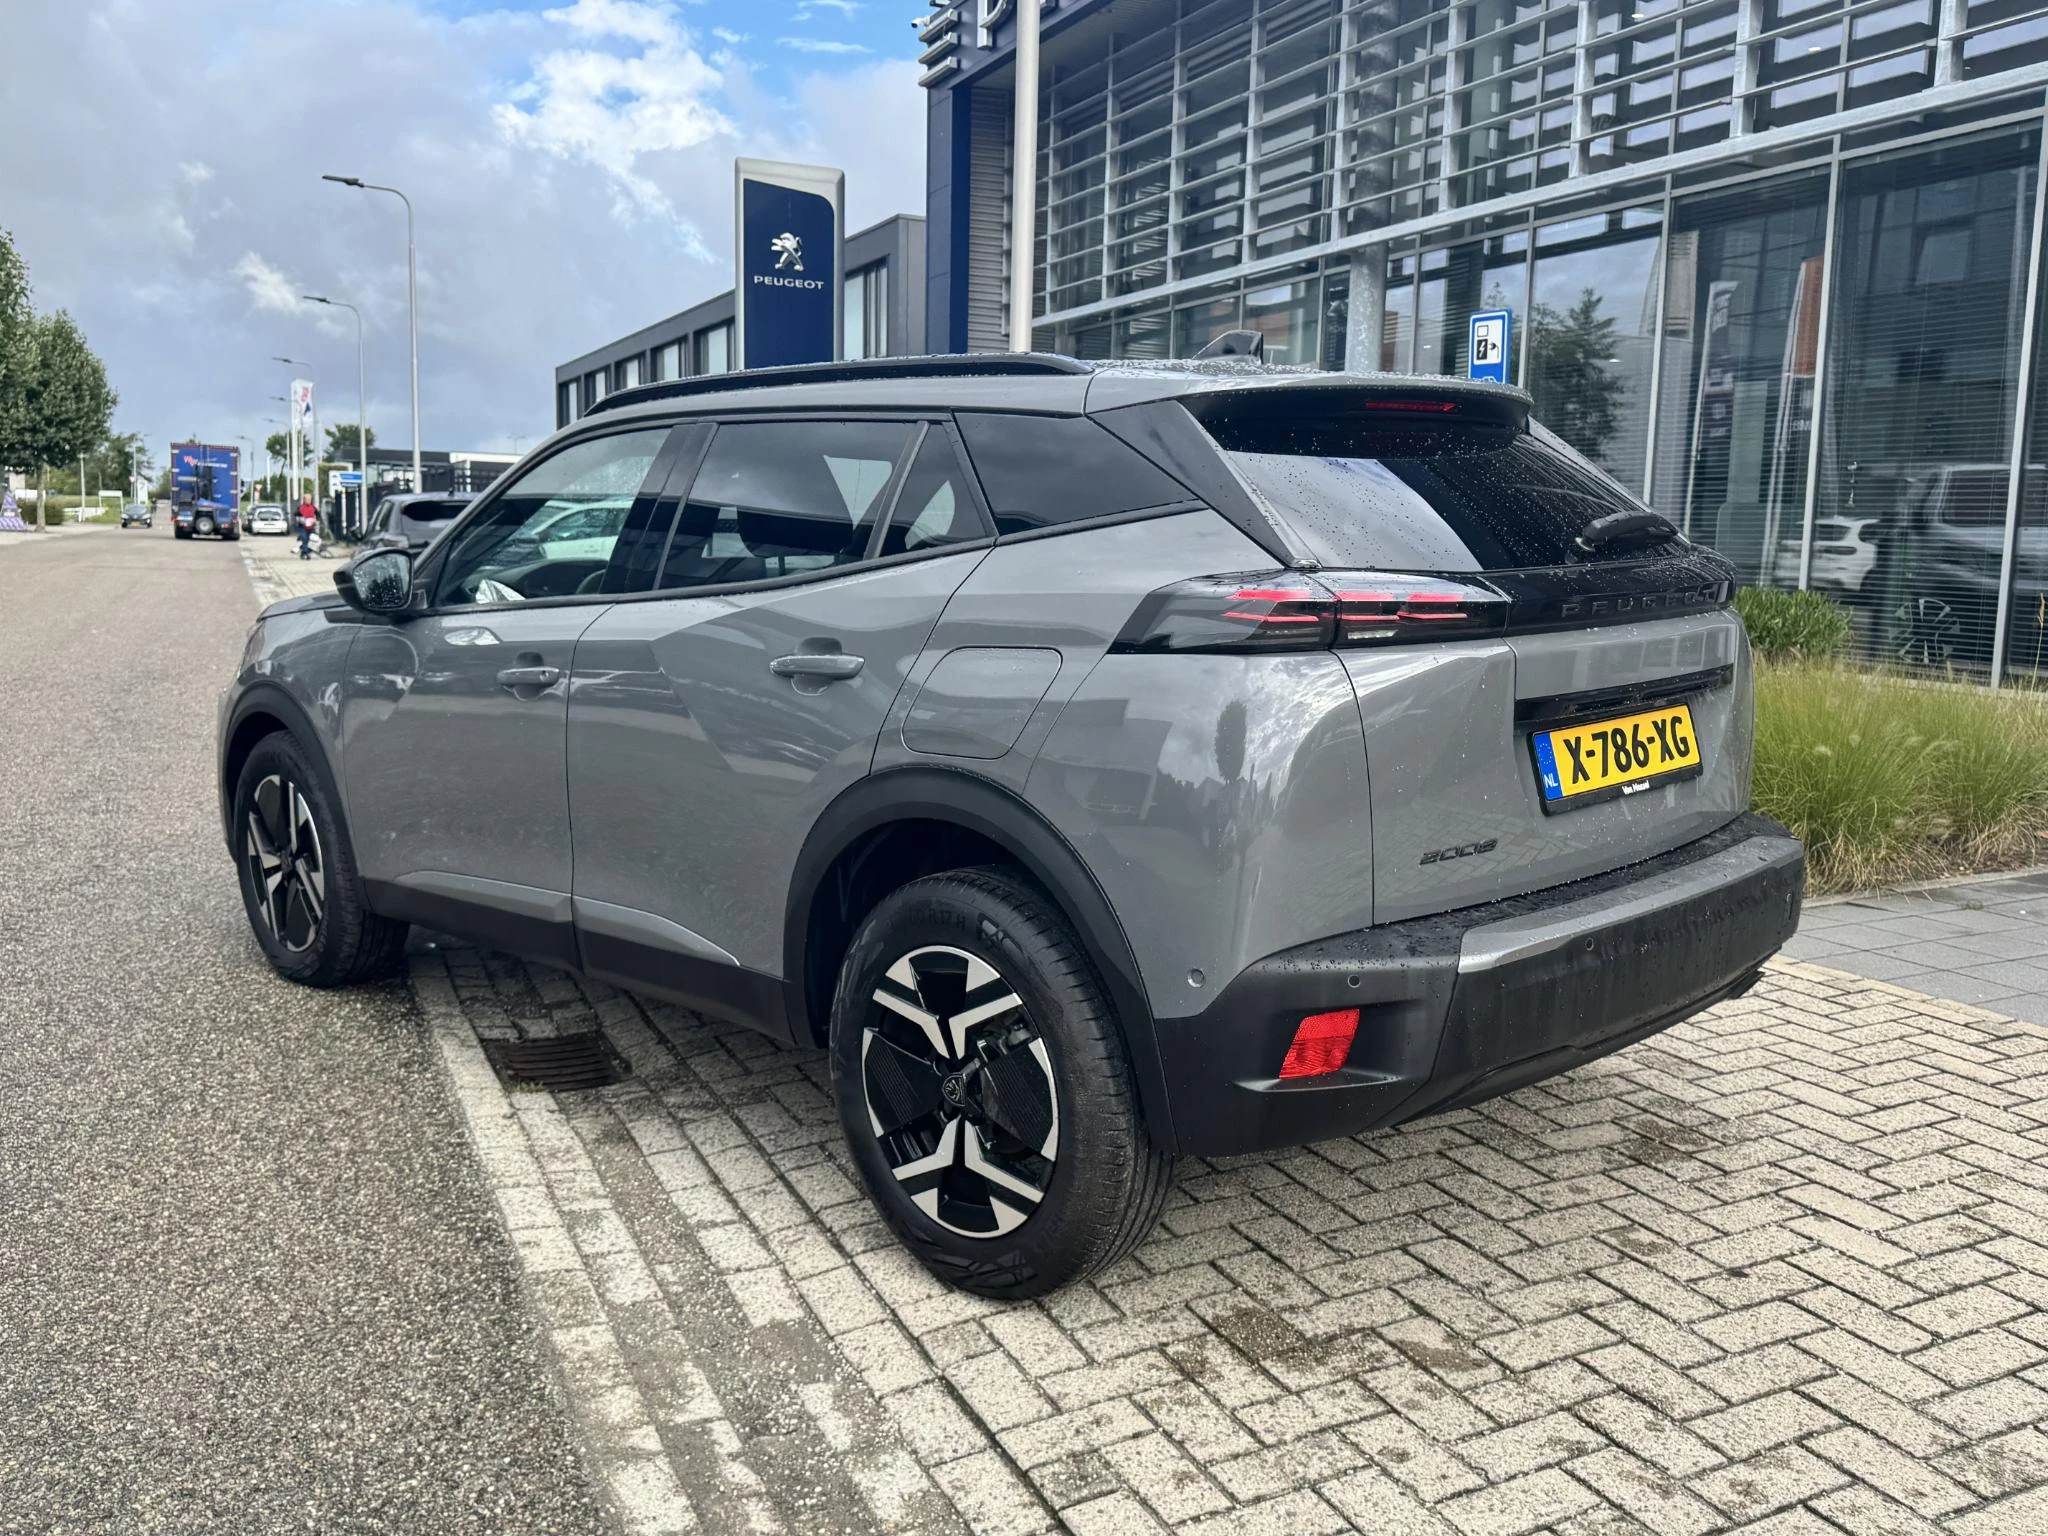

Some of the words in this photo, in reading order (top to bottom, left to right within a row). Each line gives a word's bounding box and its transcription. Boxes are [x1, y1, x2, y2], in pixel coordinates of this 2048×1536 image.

[753, 275, 825, 290] PEUGEOT
[1563, 715, 1691, 785] X-786-XG
[1543, 772, 1559, 789] NL
[1419, 838, 1498, 865] 2008
